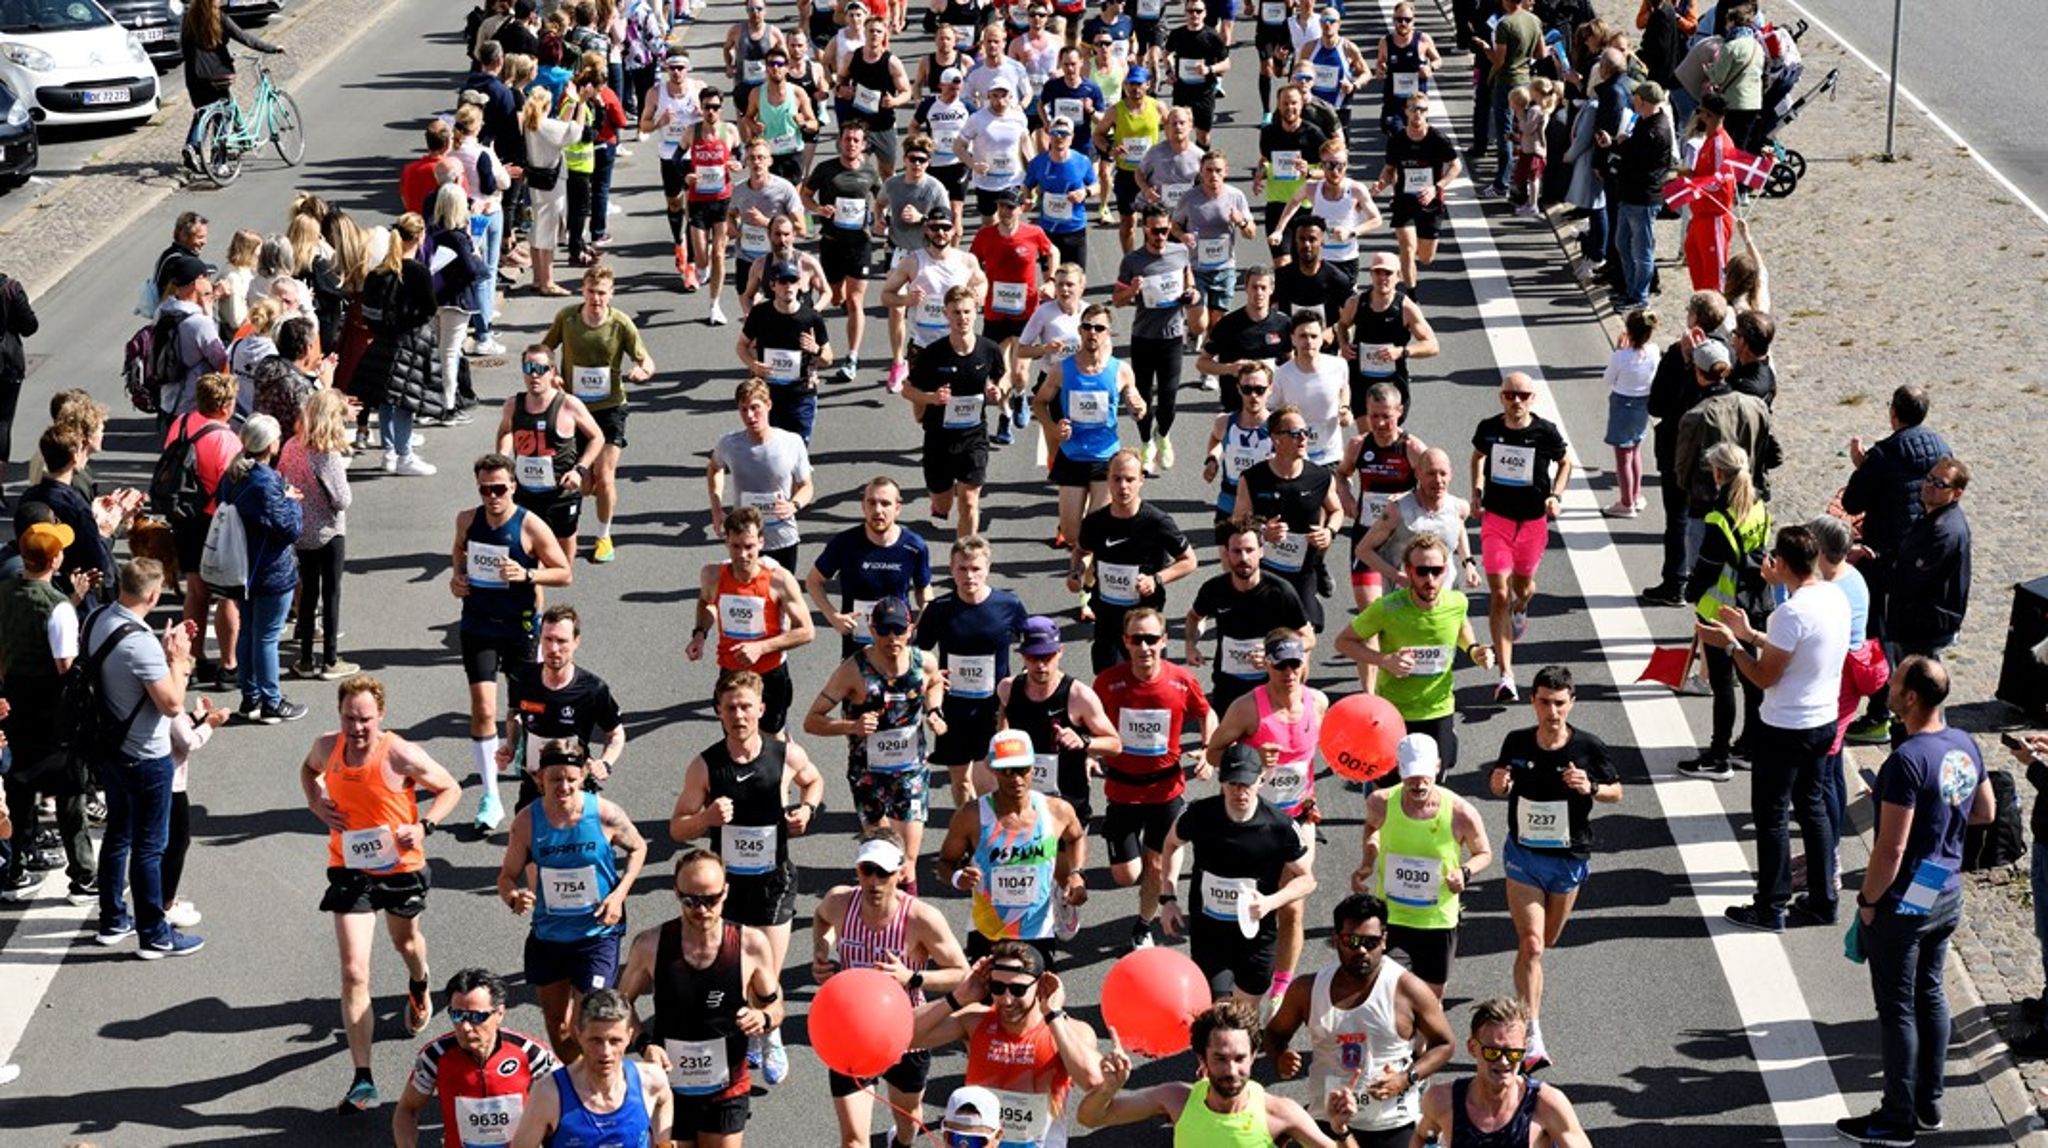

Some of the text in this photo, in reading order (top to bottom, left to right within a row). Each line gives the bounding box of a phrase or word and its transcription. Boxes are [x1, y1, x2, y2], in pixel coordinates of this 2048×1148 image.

[1079, 400, 1098, 411] 508
[1500, 457, 1526, 468] 4402
[1128, 721, 1161, 734] 11520
[1527, 813, 1556, 825] 7237
[352, 839, 383, 855] 9913
[734, 839, 765, 852] 1245
[998, 876, 1034, 888] 11047
[1395, 868, 1430, 883] 9030
[553, 881, 586, 893] 7754
[679, 1055, 712, 1069] 2312
[469, 1112, 510, 1127] 9638
